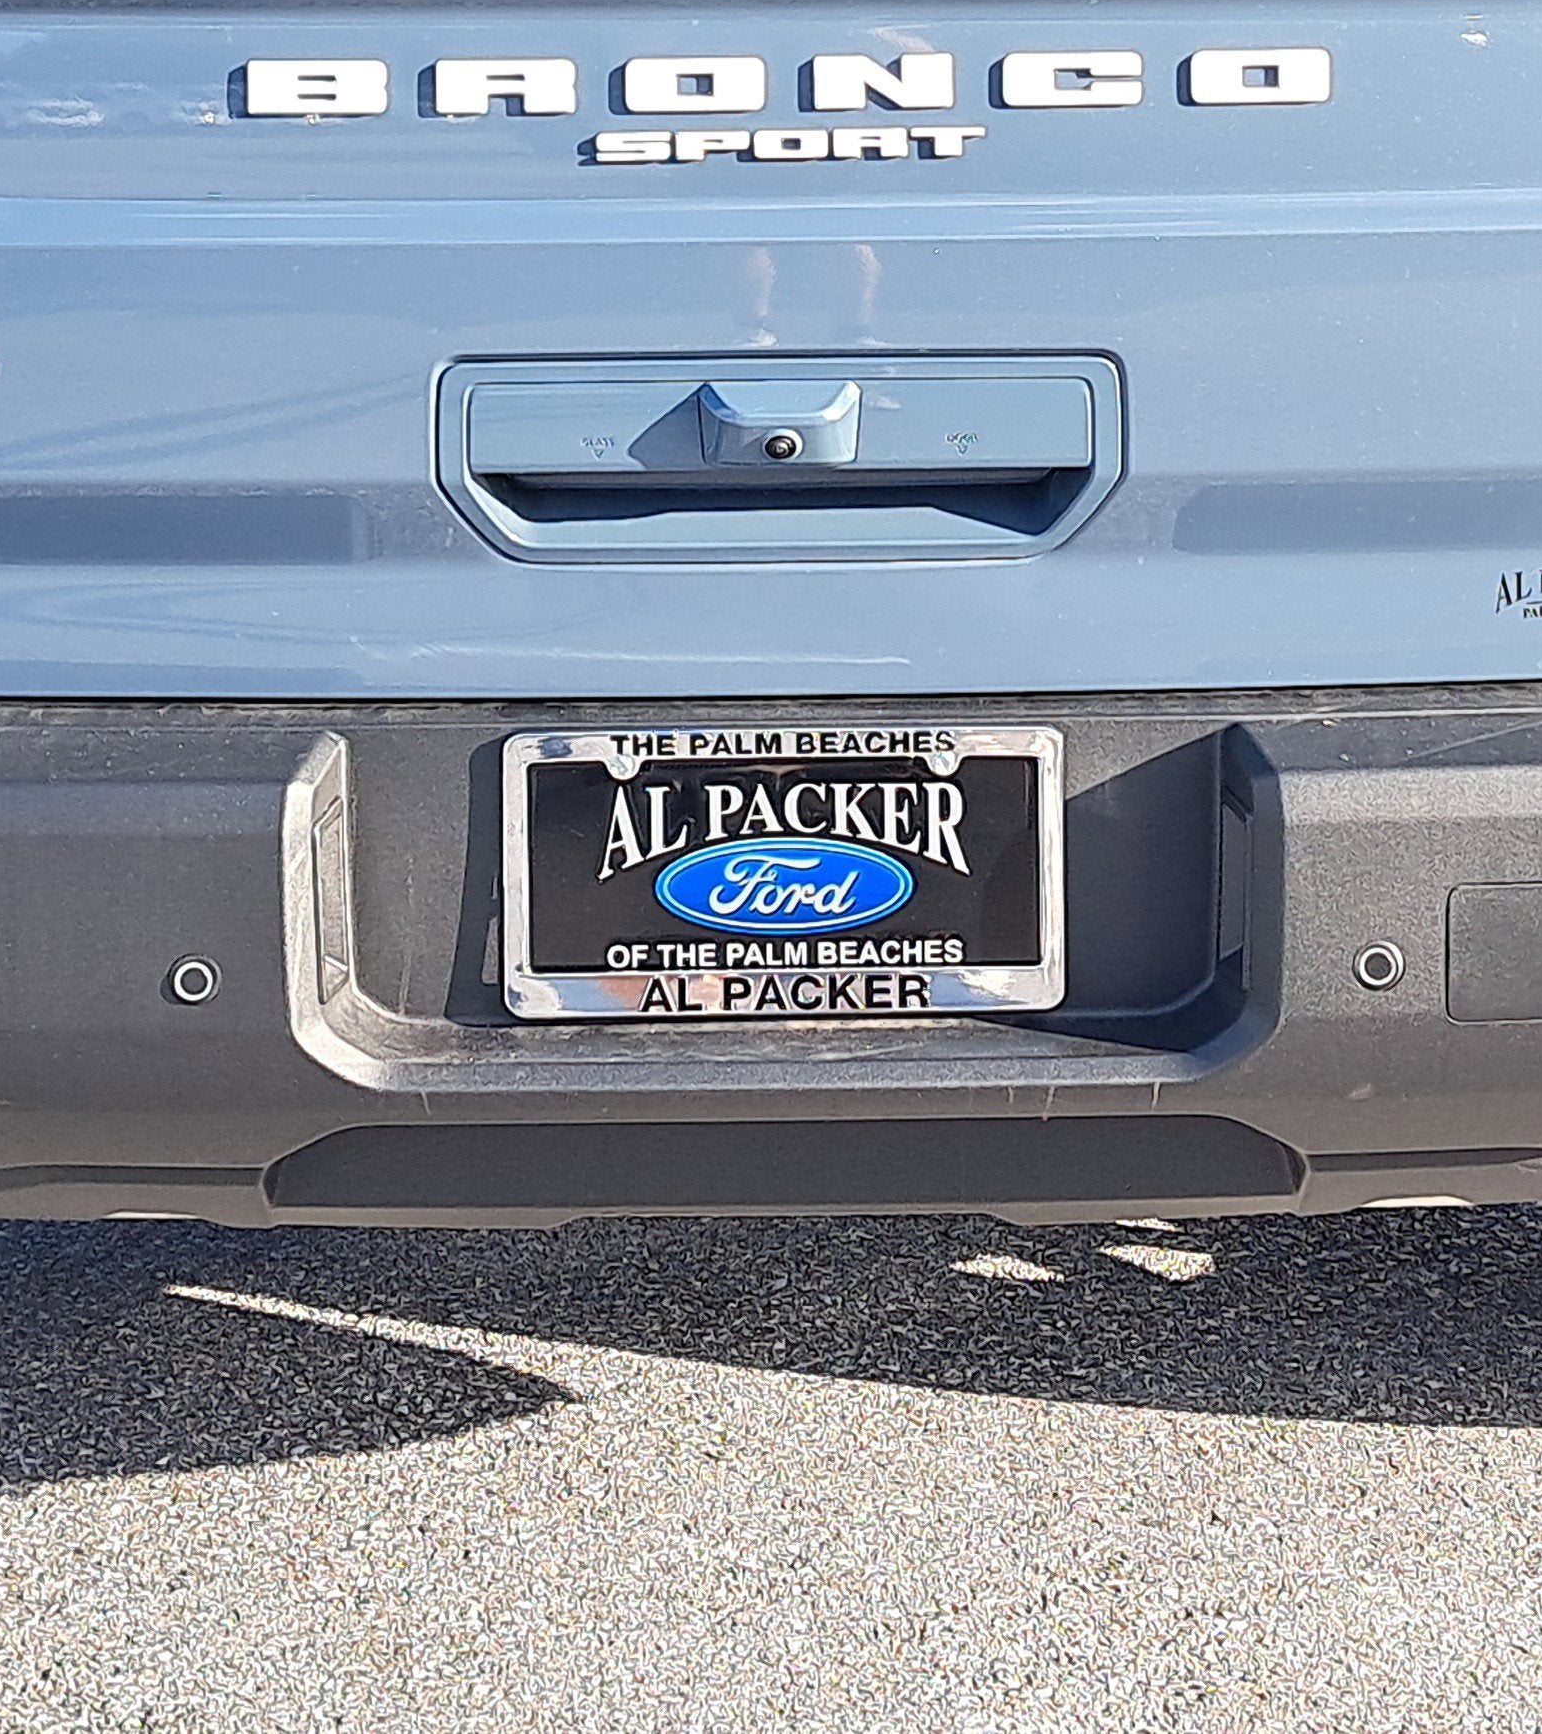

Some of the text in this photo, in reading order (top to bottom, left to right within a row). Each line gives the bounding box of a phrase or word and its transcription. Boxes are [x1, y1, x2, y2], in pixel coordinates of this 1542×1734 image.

[241, 48, 1331, 117] BRONCO
[587, 126, 986, 164] SPORT
[1495, 571, 1533, 614] AL
[609, 730, 957, 757] THE PALM BEACHES
[597, 780, 971, 883] AL PACKER
[708, 855, 859, 917] Ford
[606, 937, 964, 970] OF THE PALM BEACHES
[638, 973, 931, 1013] AL PACKER
